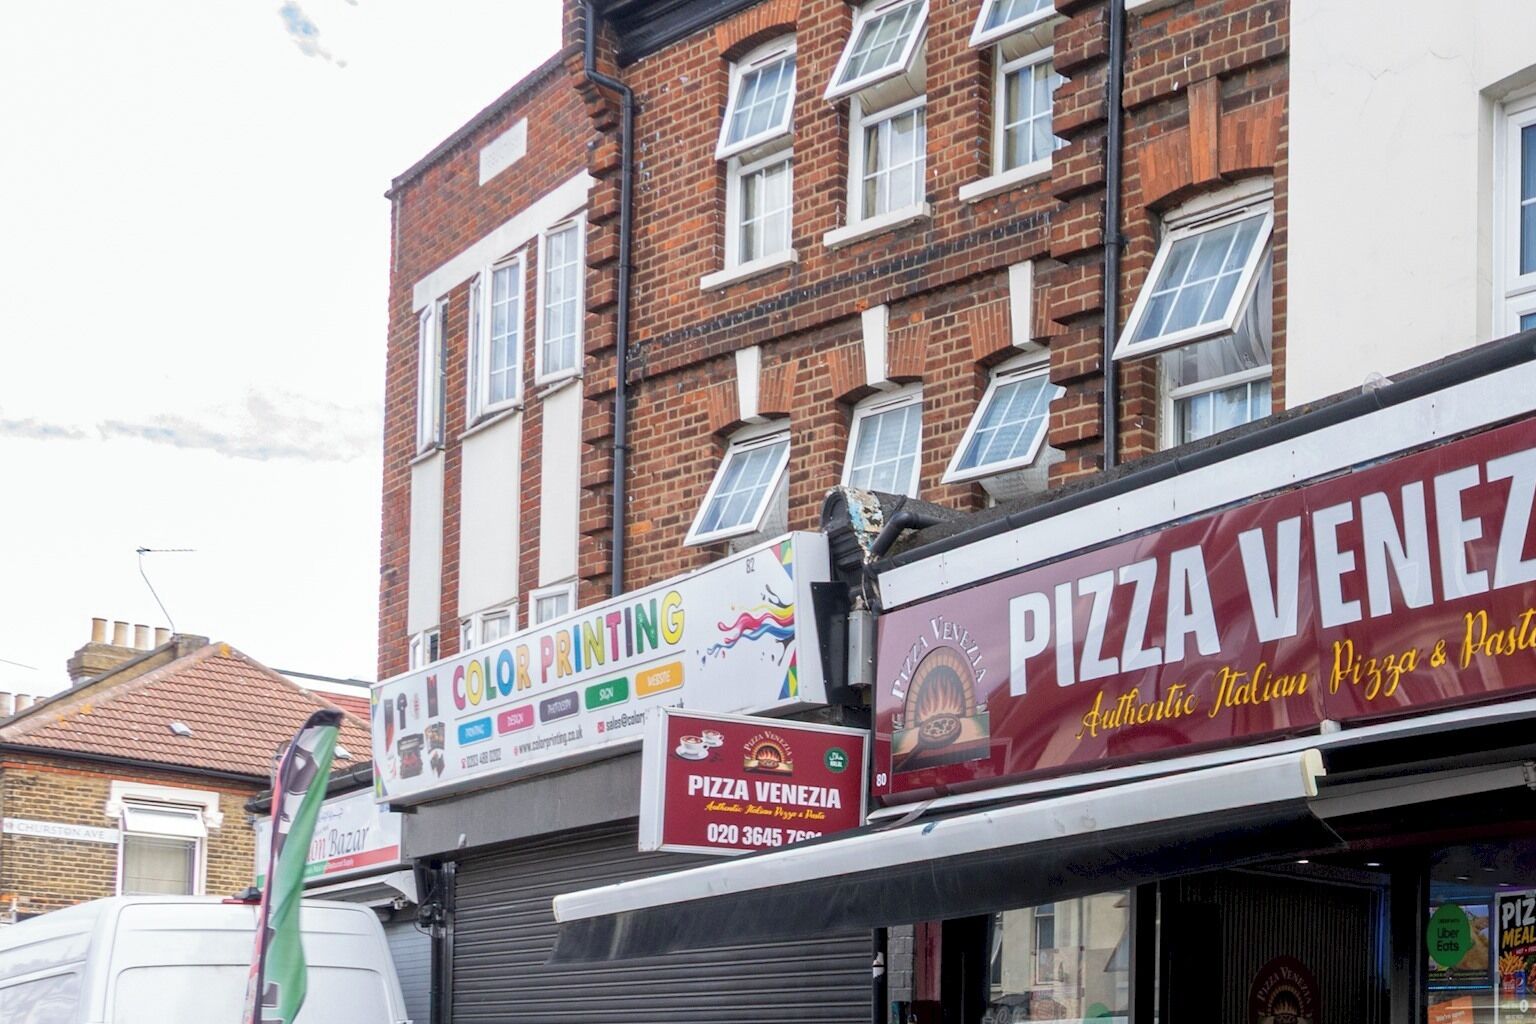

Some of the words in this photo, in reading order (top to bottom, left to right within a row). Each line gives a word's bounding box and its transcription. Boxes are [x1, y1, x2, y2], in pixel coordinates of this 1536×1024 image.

[746, 557, 755, 574] 82
[1008, 544, 1221, 697] PIZZA
[452, 643, 531, 712] COLOR
[540, 590, 685, 684] PRINTING
[891, 635, 929, 700] PIZZA
[930, 615, 988, 684] VENEZIA
[1075, 683, 1199, 741] Authentic
[1207, 660, 1316, 720] Italian
[1329, 639, 1418, 702] Pizza
[1430, 638, 1448, 667] &
[743, 733, 764, 752] PIZZA
[764, 730, 793, 757] VENEZIA
[688, 774, 750, 800] PIZZA
[755, 781, 842, 809] VENEZIA
[875, 772, 887, 788] 80
[704, 800, 743, 813] Authentic
[744, 804, 773, 816] Italian
[803, 808, 826, 820] Pasta
[17, 821, 81, 837] CHURSTON
[84, 830, 105, 840] AVE
[328, 826, 370, 857] Bazar
[707, 823, 738, 845] 020
[741, 825, 783, 848] 3645
[1436, 939, 1460, 952] Eats
[1437, 927, 1460, 940] Uber
[1257, 971, 1279, 1002] PIZZA
[1279, 966, 1312, 1004] VENEZIA
